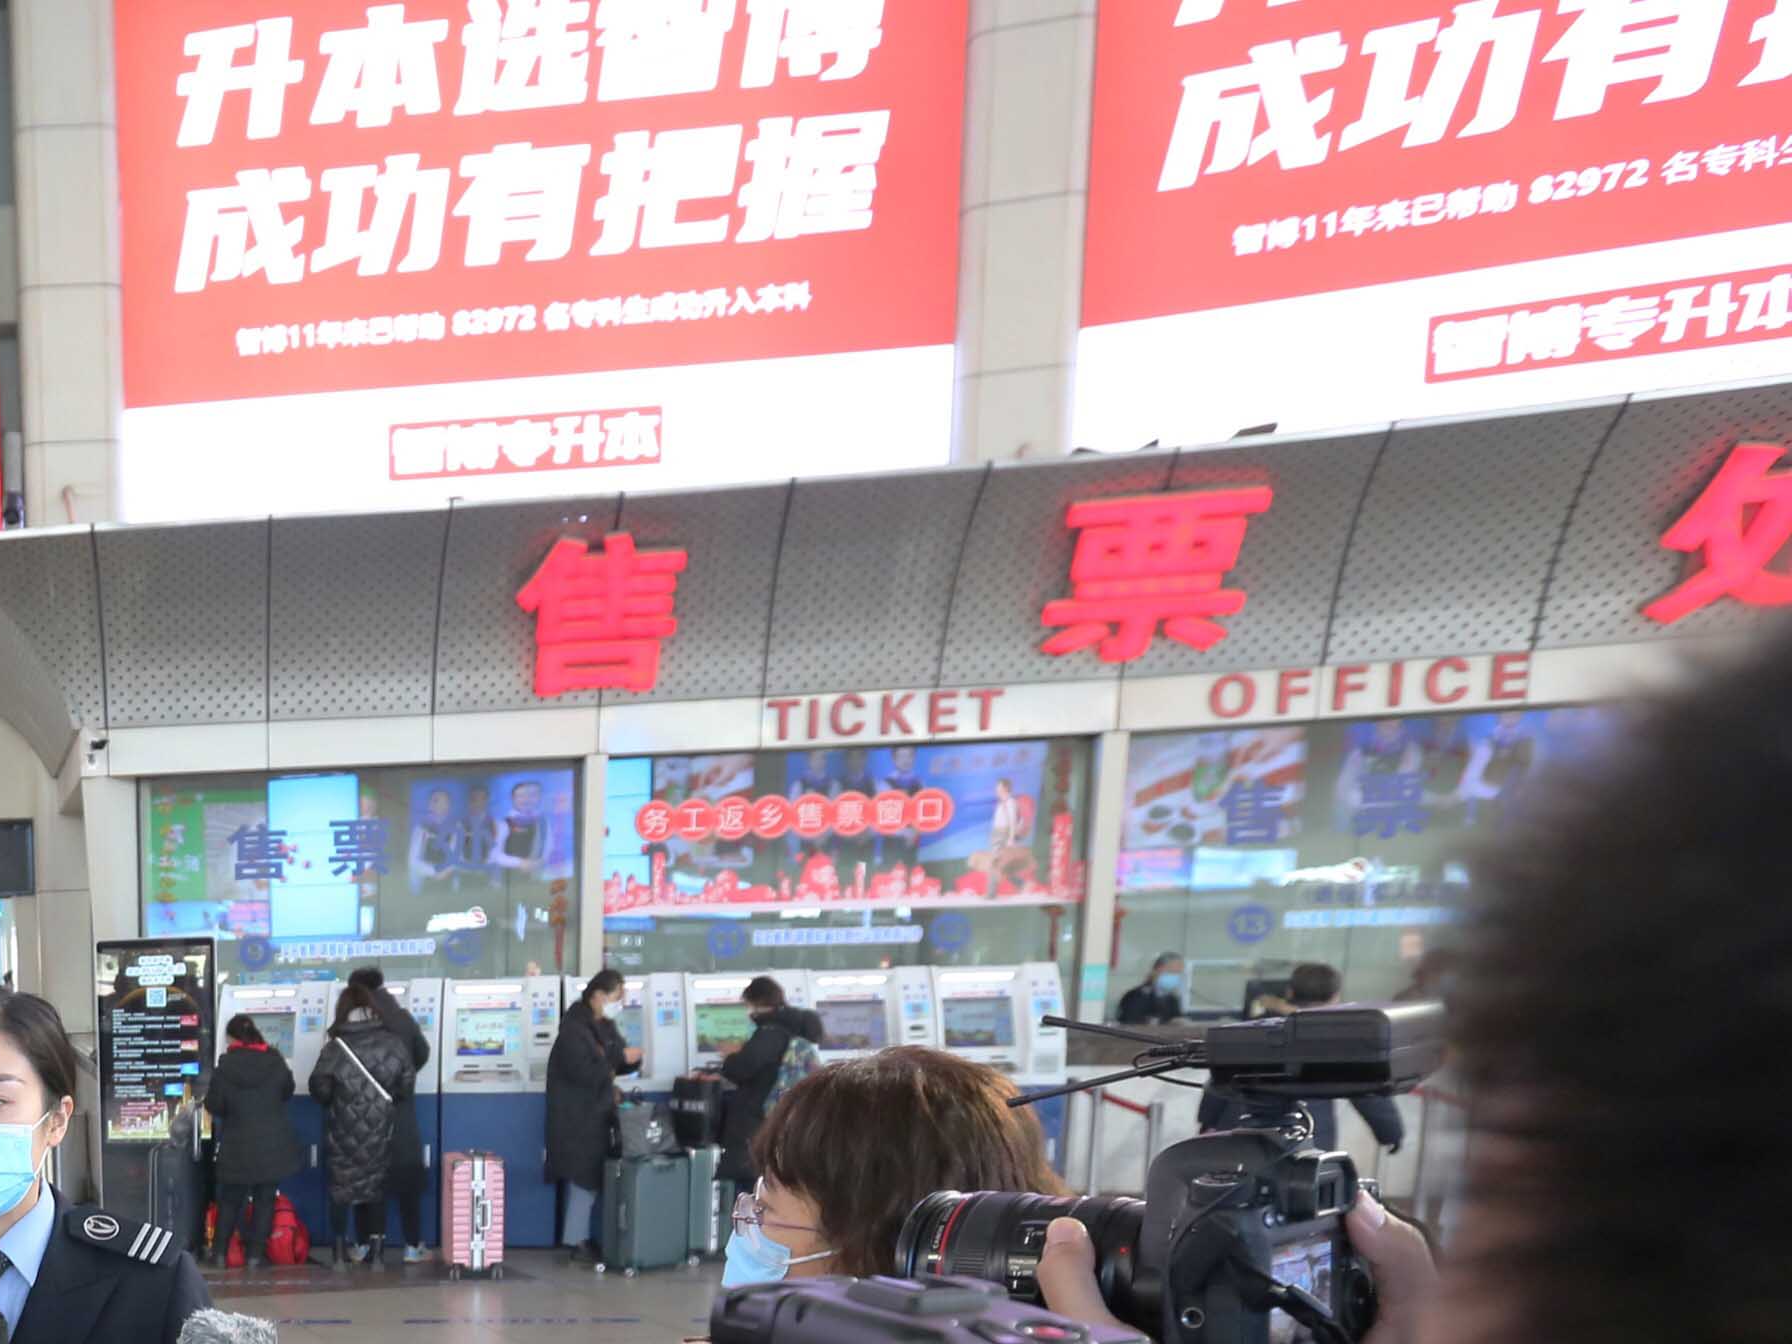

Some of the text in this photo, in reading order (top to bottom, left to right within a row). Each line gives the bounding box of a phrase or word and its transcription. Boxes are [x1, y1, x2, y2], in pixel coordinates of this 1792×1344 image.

[174, 109, 891, 294] 成功有把握
[1527, 157, 1651, 205] 82972
[1660, 134, 1792, 186] 名专科
[767, 652, 1532, 742] TICKET OFFICE
[642, 798, 945, 834] 务工返乡售票窗口
